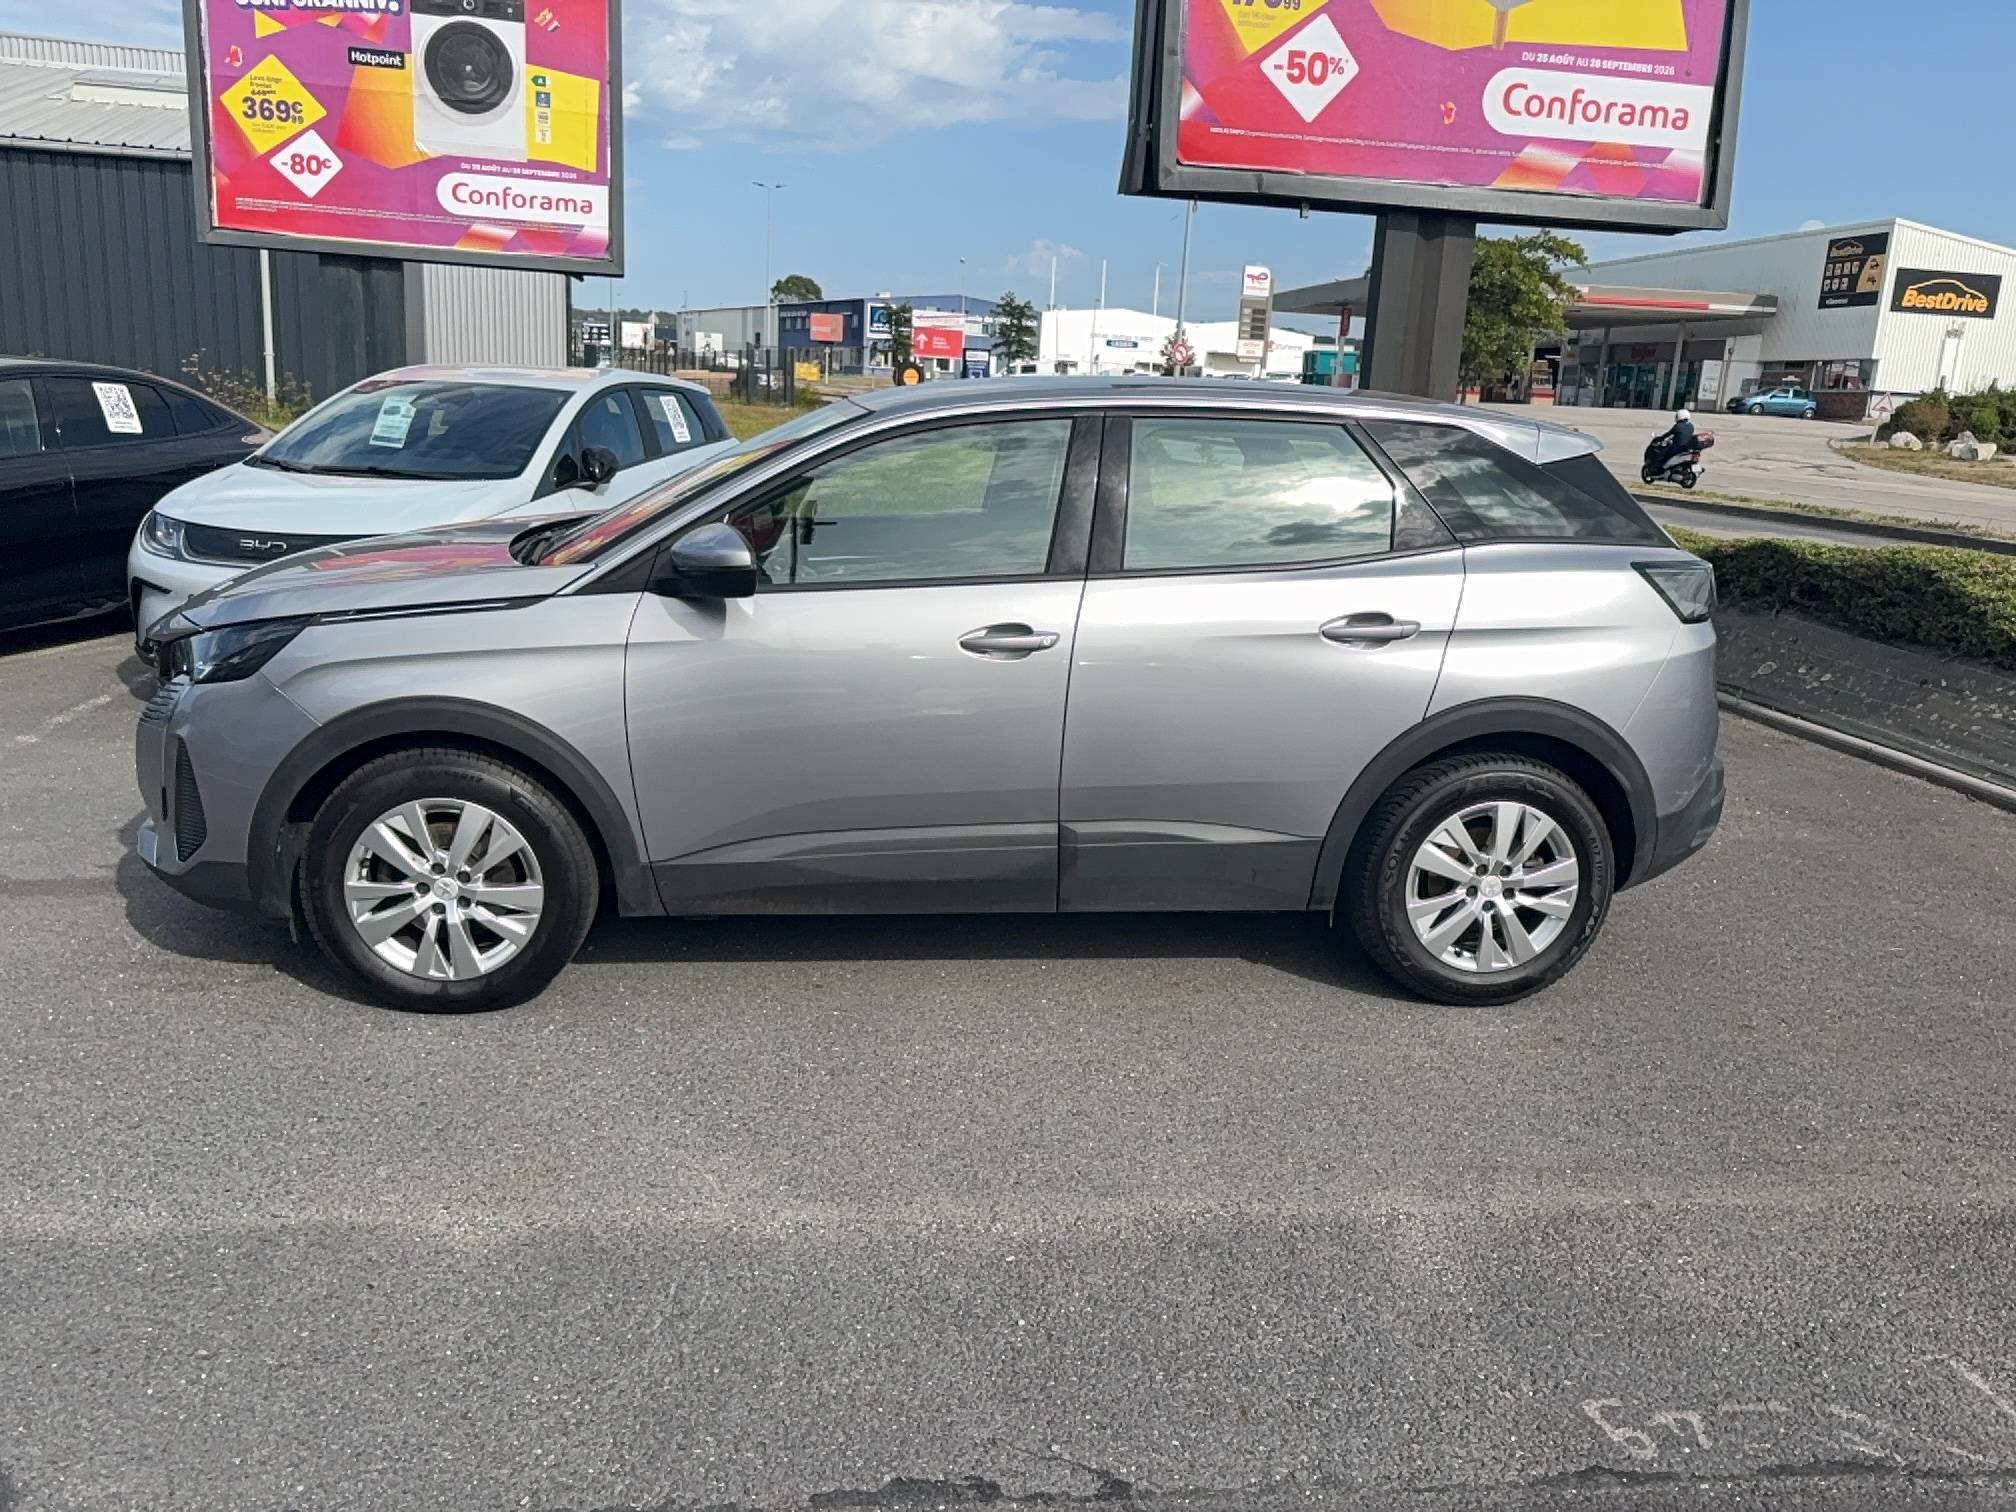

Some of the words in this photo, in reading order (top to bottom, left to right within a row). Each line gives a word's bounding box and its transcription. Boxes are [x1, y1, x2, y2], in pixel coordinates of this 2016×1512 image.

[351, 50, 403, 66] Hotpoint
[1521, 51, 1535, 62] DU
[1548, 53, 1575, 66] AOÛT
[1576, 57, 1588, 67] AU
[1601, 59, 1653, 74] SEPTEMBRE
[1502, 83, 1690, 131] Conforama
[452, 182, 593, 214] Conforama
[1901, 288, 1989, 313] BestDrive
[239, 538, 287, 553] BYD
